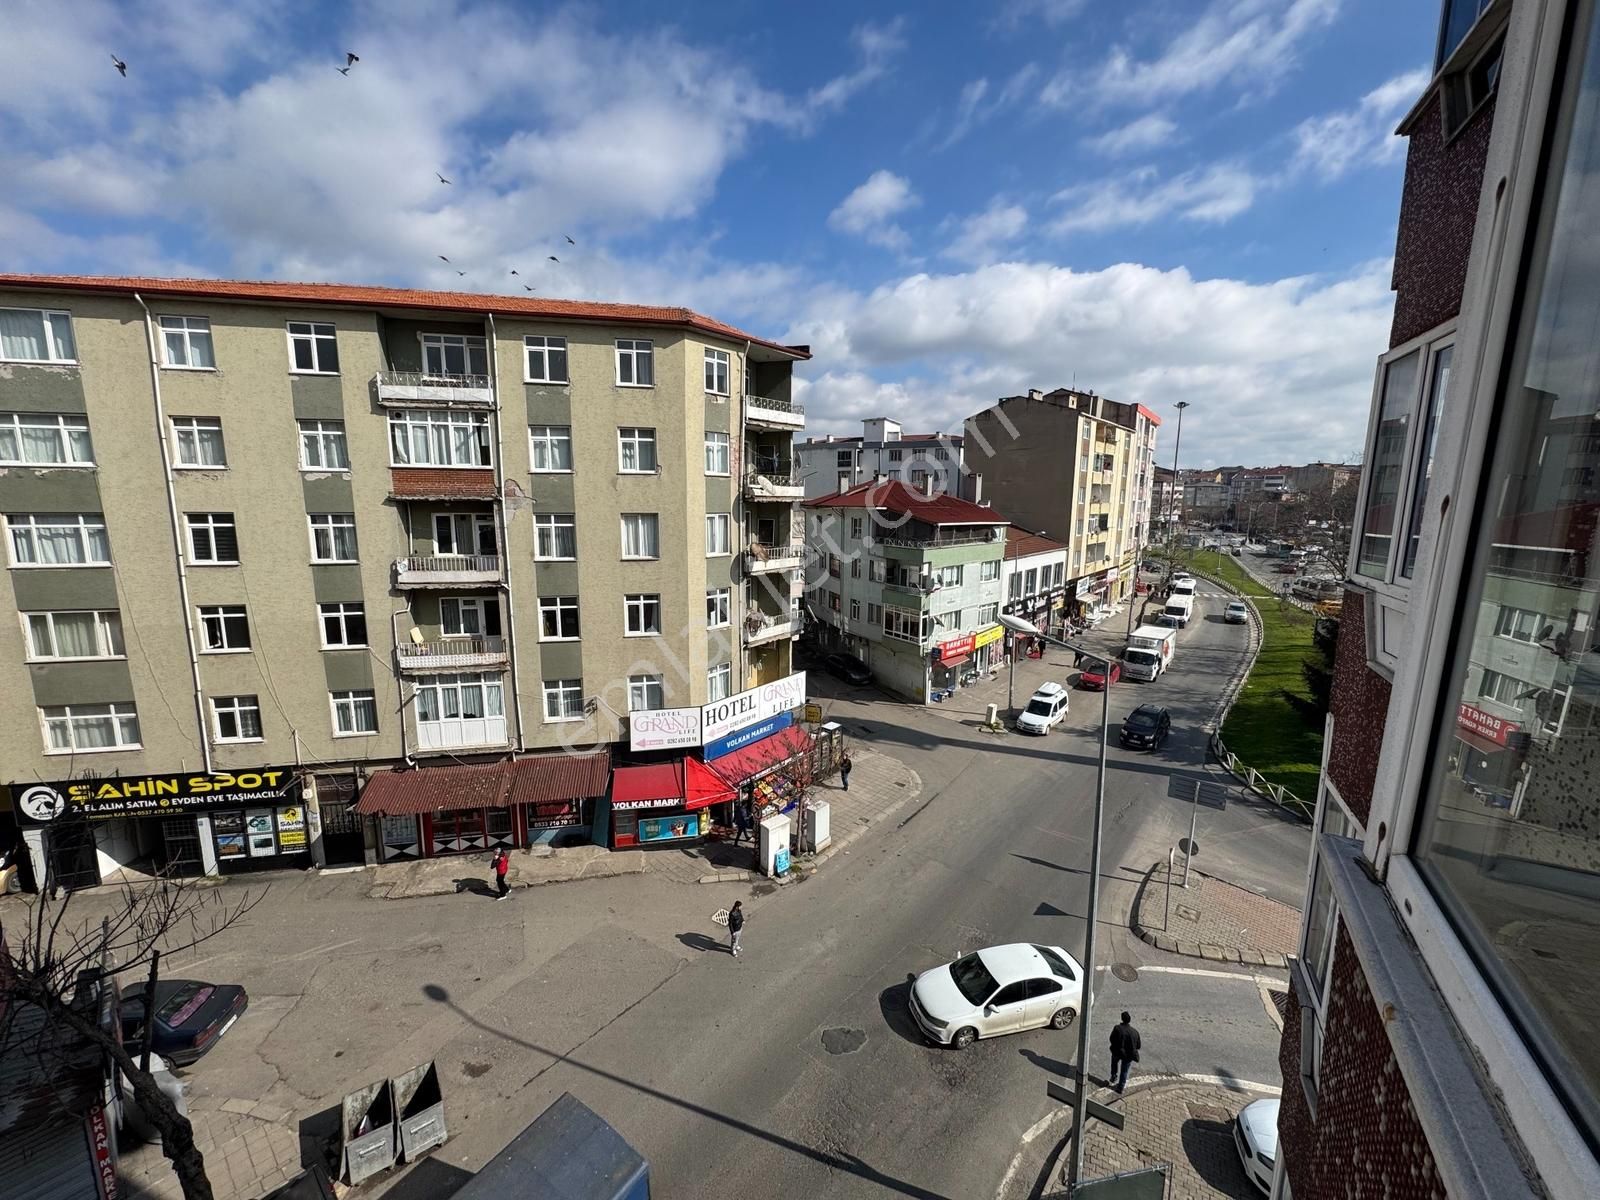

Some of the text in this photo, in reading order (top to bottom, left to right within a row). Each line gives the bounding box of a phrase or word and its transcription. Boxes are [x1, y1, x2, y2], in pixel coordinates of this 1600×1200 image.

[763, 677, 804, 703] GRAND
[705, 695, 757, 727] HOTEL
[772, 697, 795, 713] LIFE
[634, 715, 698, 734] GRAND
[726, 723, 774, 749] VOLKAN MARKET
[188, 772, 284, 793] SPOT
[84, 804, 97, 812] EL
[98, 801, 124, 811] ALIM
[126, 799, 158, 809] SATIM
[171, 796, 204, 806] EVDEN
[206, 794, 225, 803] EVE
[613, 799, 652, 809] VOLKAN
